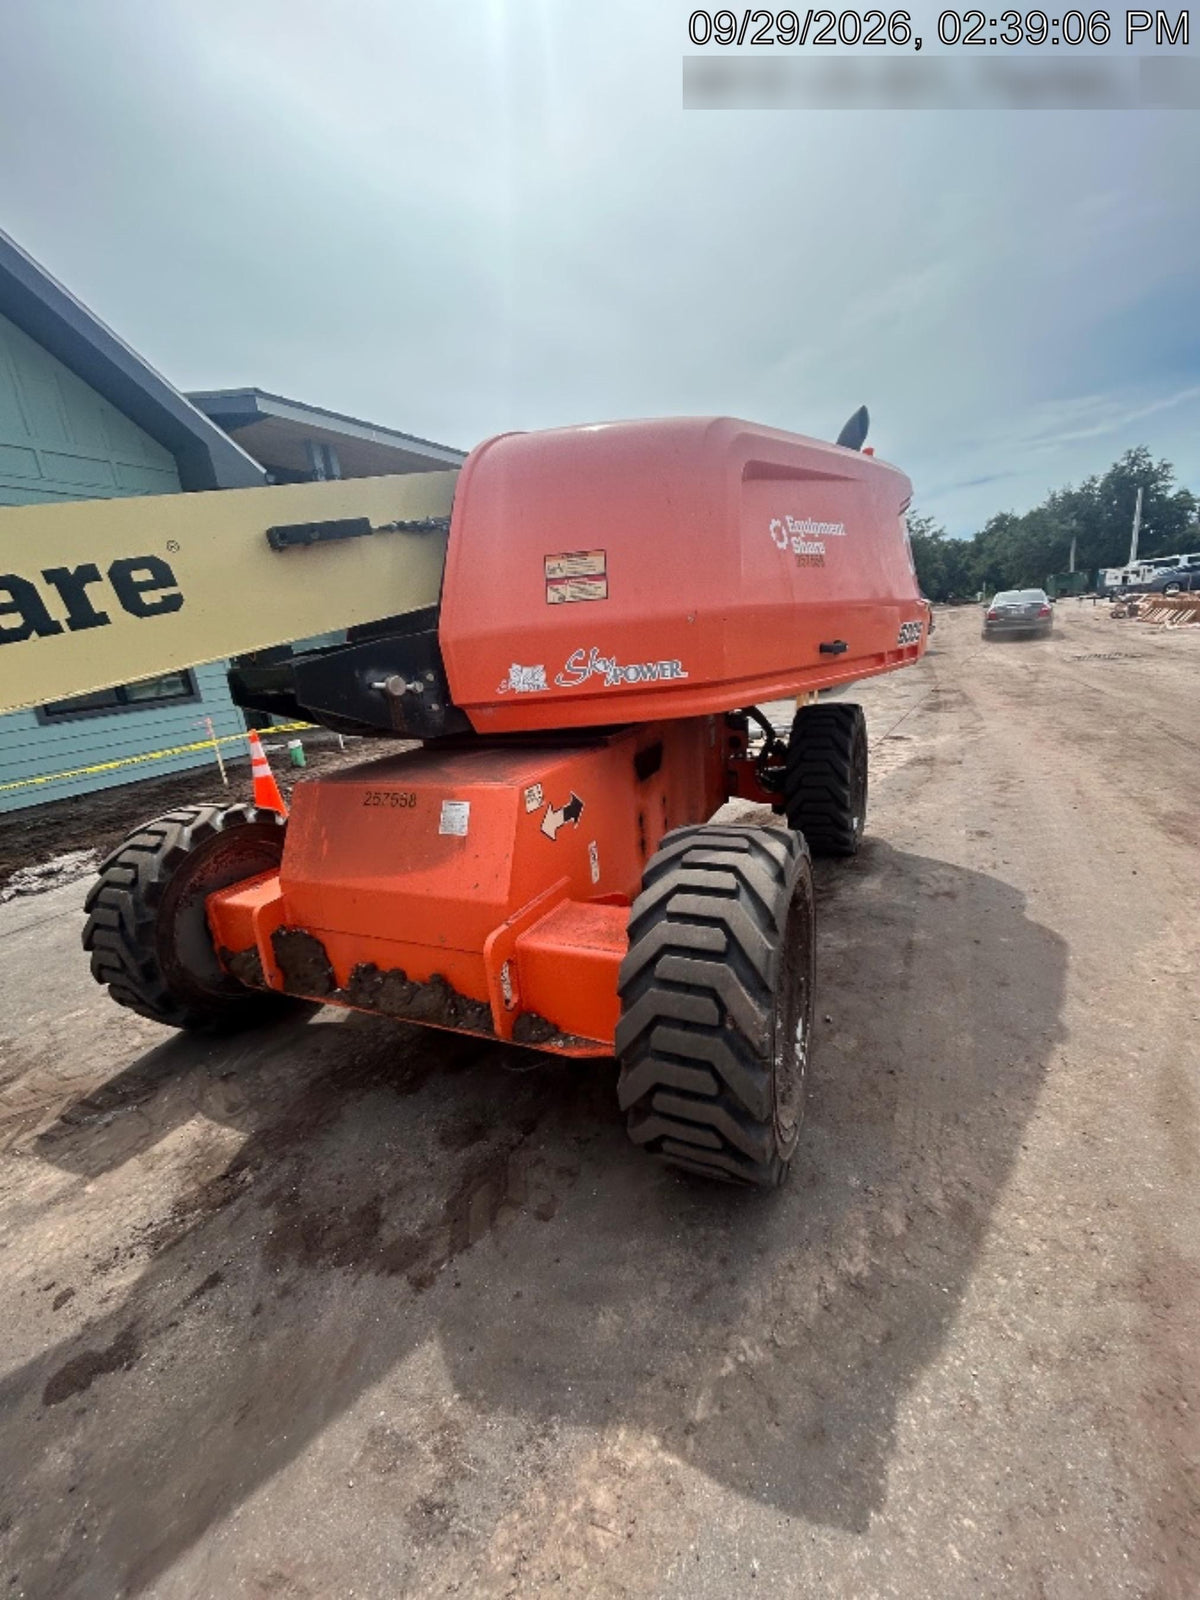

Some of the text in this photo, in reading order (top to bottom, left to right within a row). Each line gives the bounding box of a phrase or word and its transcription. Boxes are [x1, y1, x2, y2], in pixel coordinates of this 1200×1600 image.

[785, 515, 847, 537] Equipment
[791, 536, 826, 554] Share
[555, 647, 616, 687] Sky
[611, 659, 689, 686] POWER
